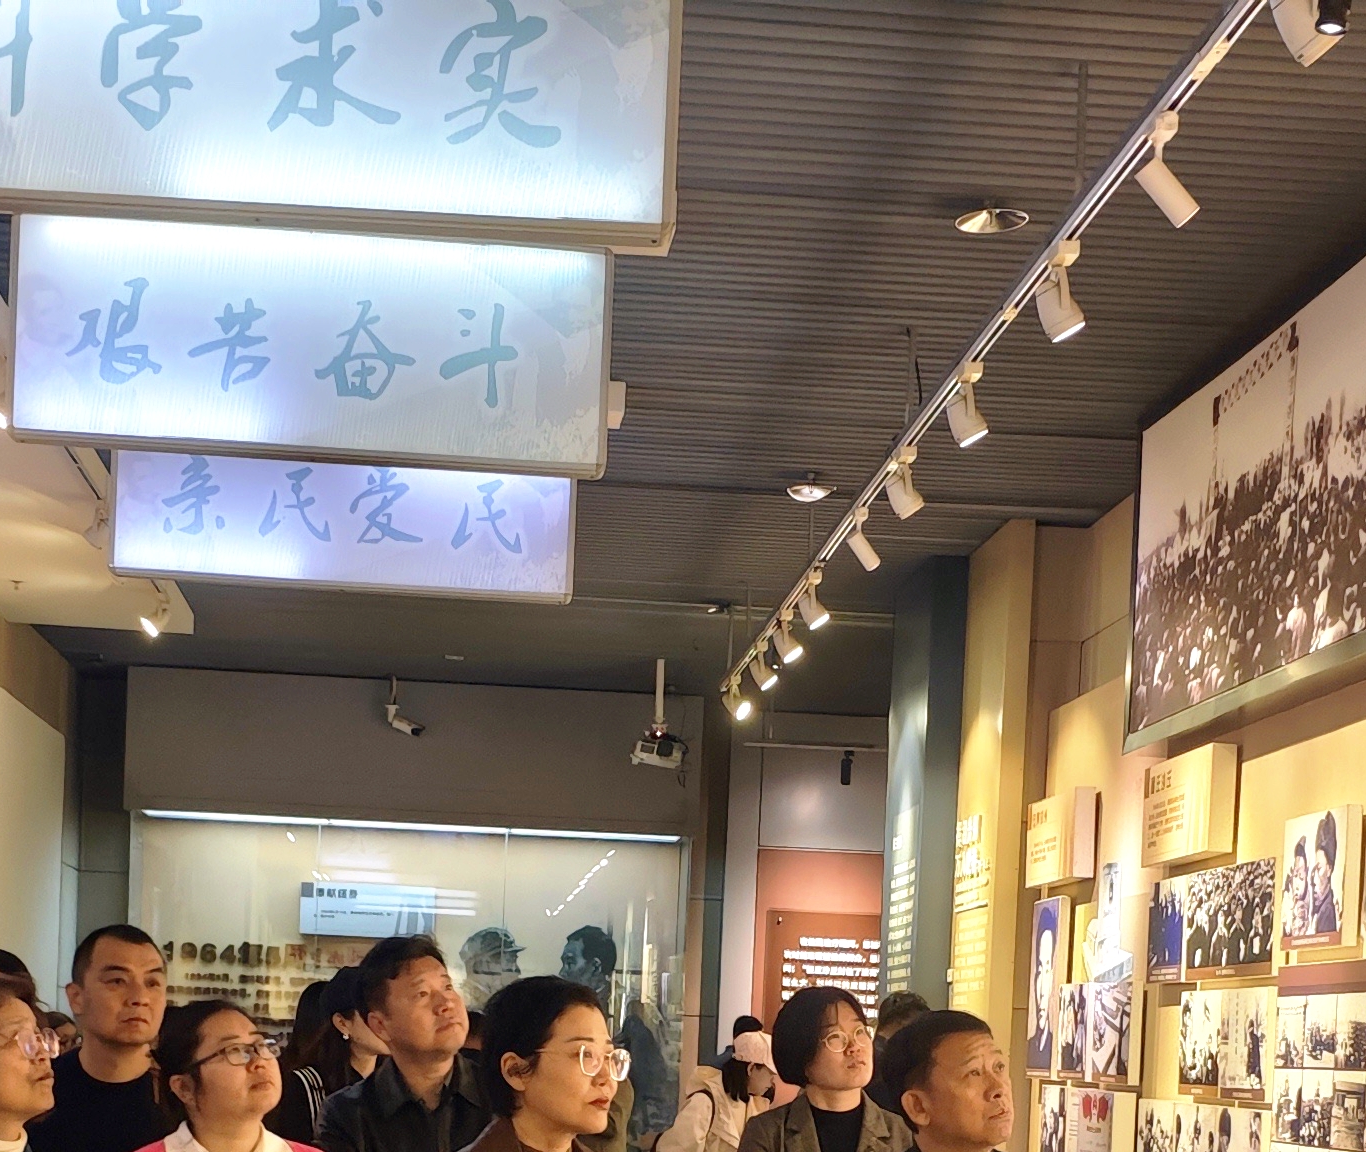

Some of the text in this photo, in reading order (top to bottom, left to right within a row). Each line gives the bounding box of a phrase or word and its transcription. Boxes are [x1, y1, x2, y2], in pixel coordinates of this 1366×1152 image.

[66, 277, 522, 409] 艰苦奋斗
[162, 456, 523, 556] 亲民爱民
